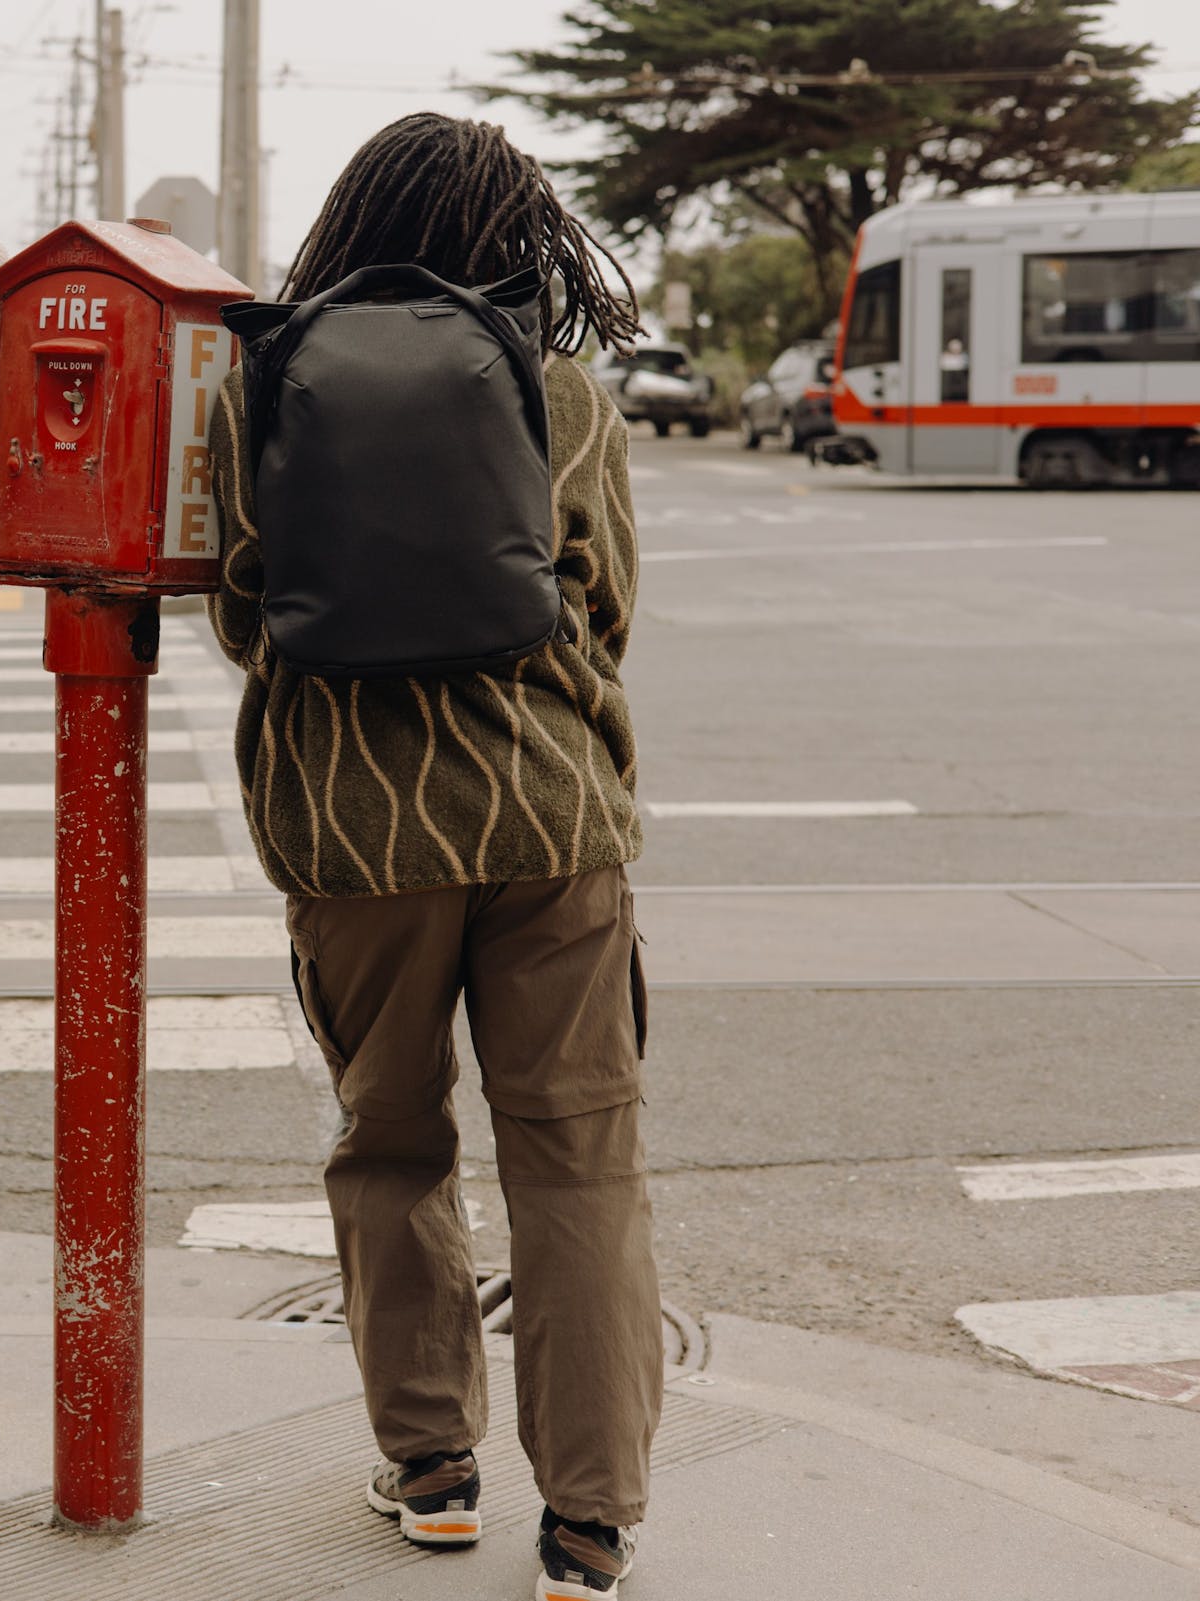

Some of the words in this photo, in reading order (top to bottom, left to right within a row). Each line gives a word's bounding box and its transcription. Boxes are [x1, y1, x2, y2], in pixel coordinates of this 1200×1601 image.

[64, 284, 86, 294] FOR
[39, 297, 108, 331] FIRE
[48, 361, 68, 370] PULL
[69, 362, 93, 370] DOWN
[180, 329, 217, 552] FIRE
[54, 441, 77, 451] HOOK
